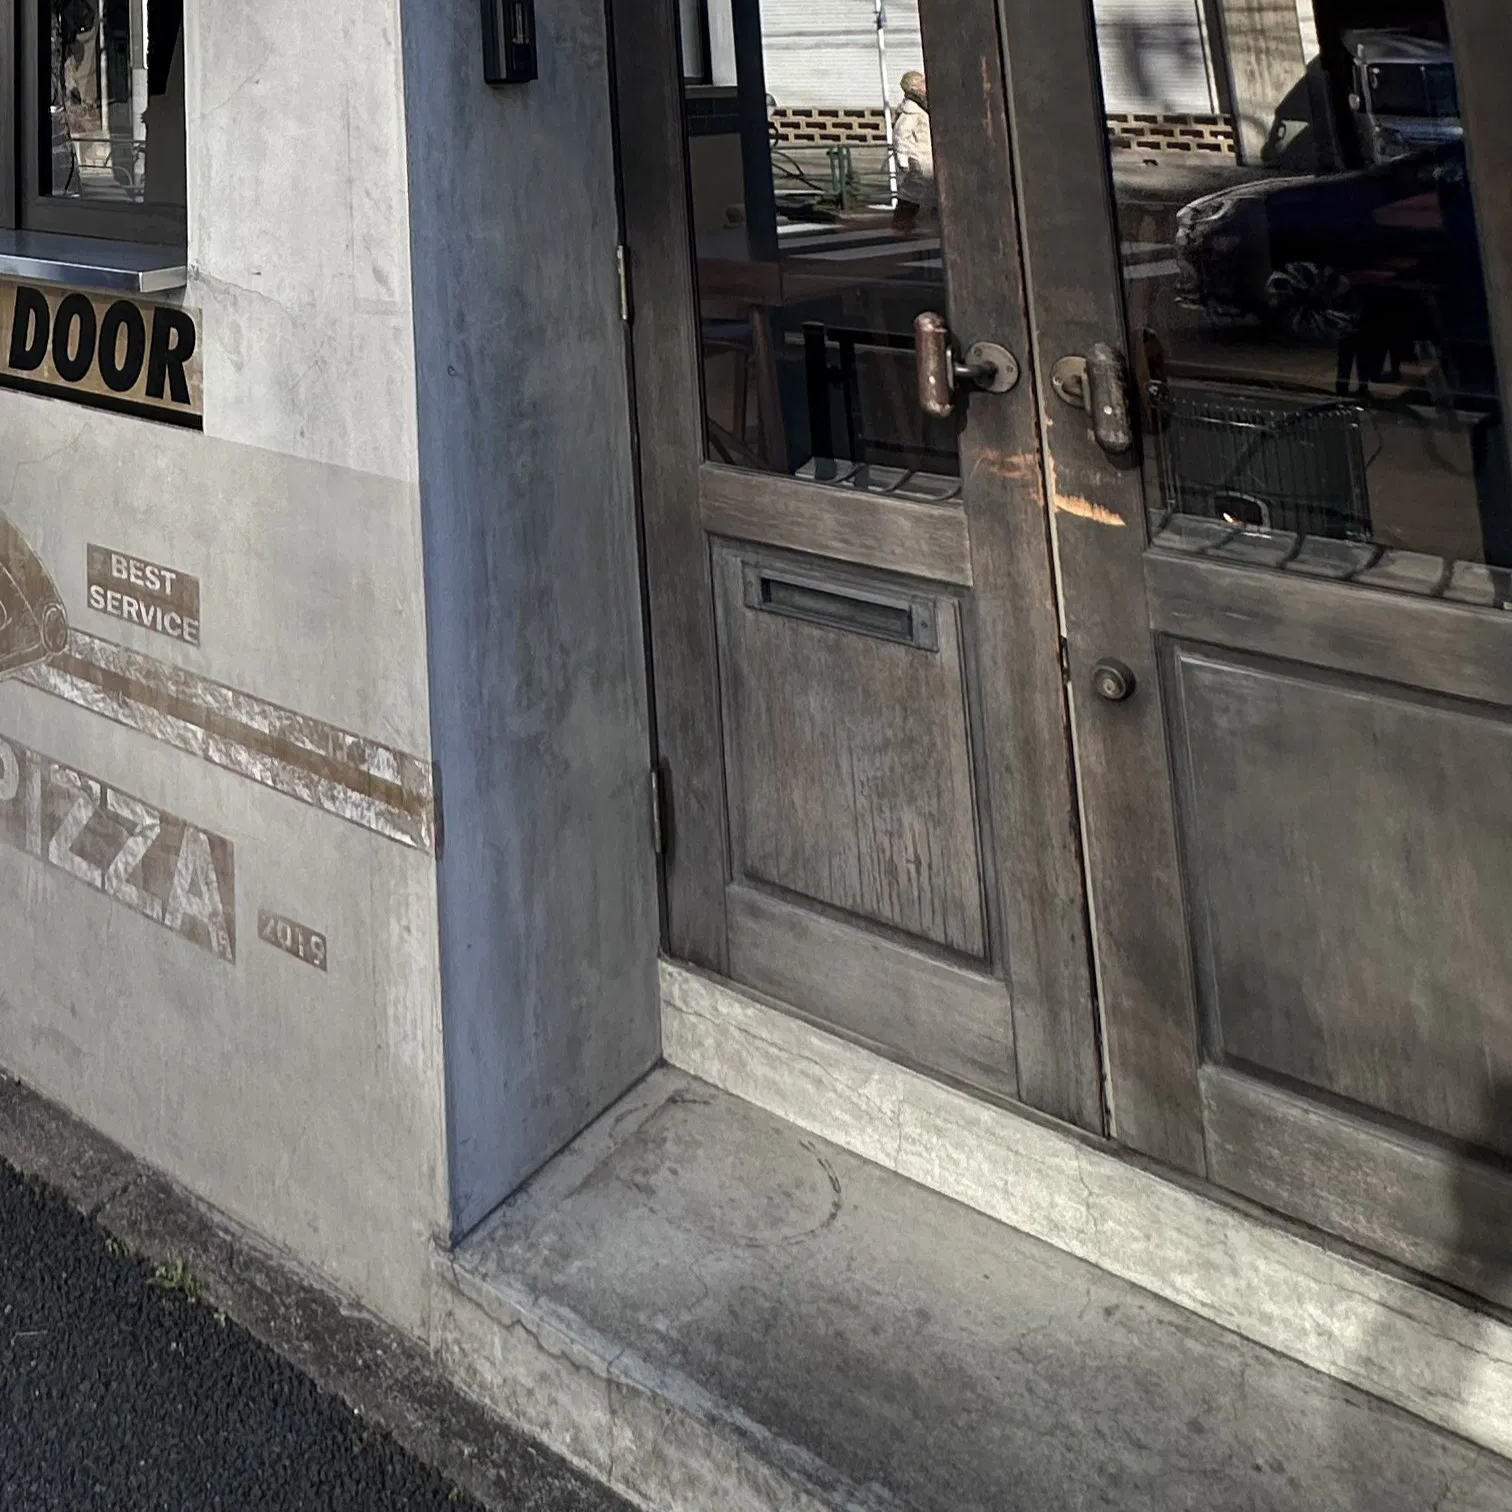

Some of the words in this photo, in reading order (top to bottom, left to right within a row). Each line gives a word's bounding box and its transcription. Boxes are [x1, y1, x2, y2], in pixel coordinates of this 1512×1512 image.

[8, 285, 196, 405] DOOR
[111, 553, 176, 595] BEST
[90, 584, 199, 645] SERVICE
